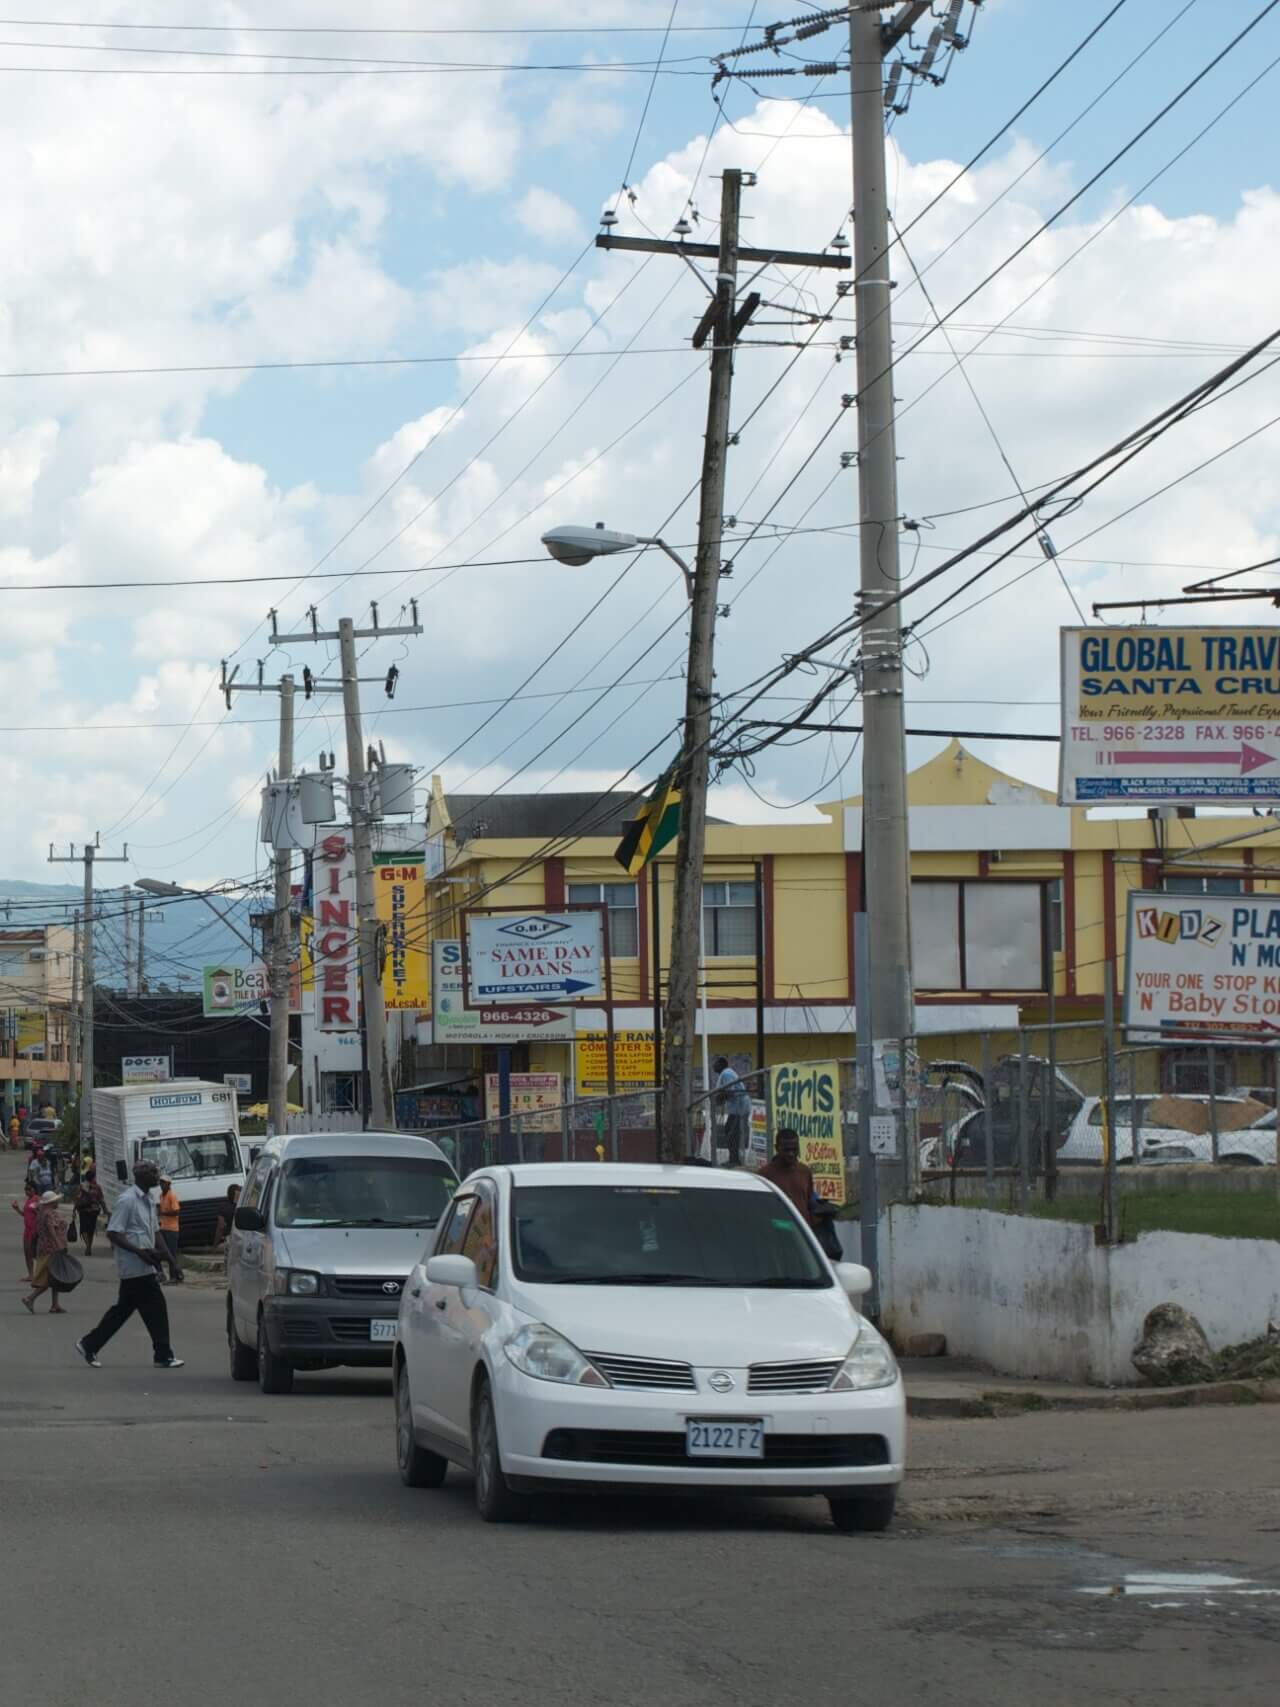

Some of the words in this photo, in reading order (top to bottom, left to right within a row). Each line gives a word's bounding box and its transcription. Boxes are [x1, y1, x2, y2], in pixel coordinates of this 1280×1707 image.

[1081, 637, 1191, 672] GLOBAL
[1201, 637, 1280, 671] TRAV
[1082, 678, 1201, 695] SANTA
[1080, 705, 1103, 718] Your
[1072, 727, 1098, 741] TEL.
[1104, 726, 1184, 741] 966-2328
[322, 836, 352, 1024] SINGER
[1138, 910, 1222, 943] KIDZ
[491, 948, 548, 963] SAME
[555, 946, 593, 960] DAY
[501, 961, 573, 977] LOANS
[485, 984, 561, 993] UPSTAIRS
[1136, 973, 1170, 988] YOUR
[1176, 974, 1203, 989] ONE
[1214, 975, 1256, 990] STOP
[1169, 992, 1227, 1016] Baby
[483, 1012, 550, 1021] 966-4326
[587, 1033, 619, 1041] BLE
[580, 1043, 640, 1051] COMUTER
[125, 1058, 163, 1066] DOC'S
[776, 1067, 833, 1112] Girls
[692, 1427, 734, 1448] 2122
